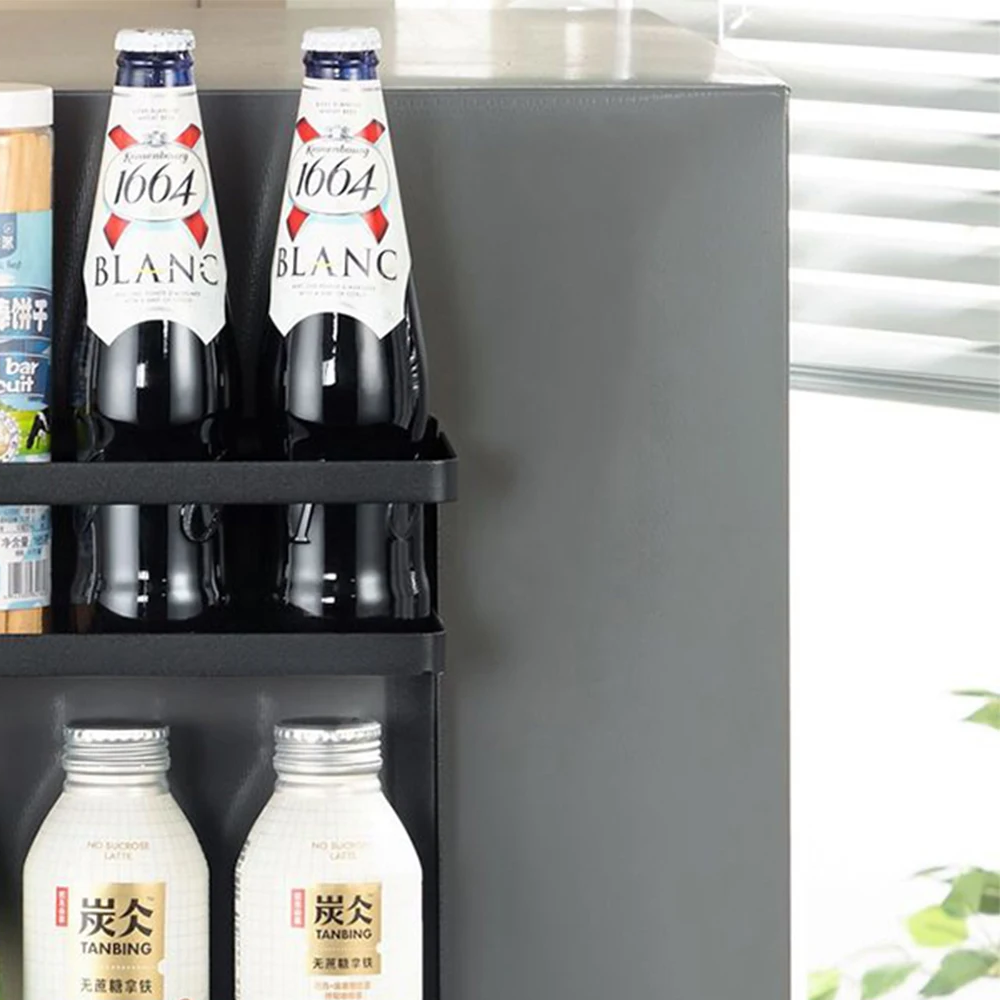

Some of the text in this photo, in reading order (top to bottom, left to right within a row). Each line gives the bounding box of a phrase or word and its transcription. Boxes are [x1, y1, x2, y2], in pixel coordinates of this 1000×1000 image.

[114, 162, 197, 207] 1664
[295, 156, 377, 202] 1664
[94, 253, 219, 287] BLANC
[276, 246, 398, 281] BLANC
[6, 357, 40, 375] bar
[316, 928, 373, 940] TANBING
[81, 941, 153, 955] TANBING
[80, 977, 153, 995] 无蔗糖拿铁
